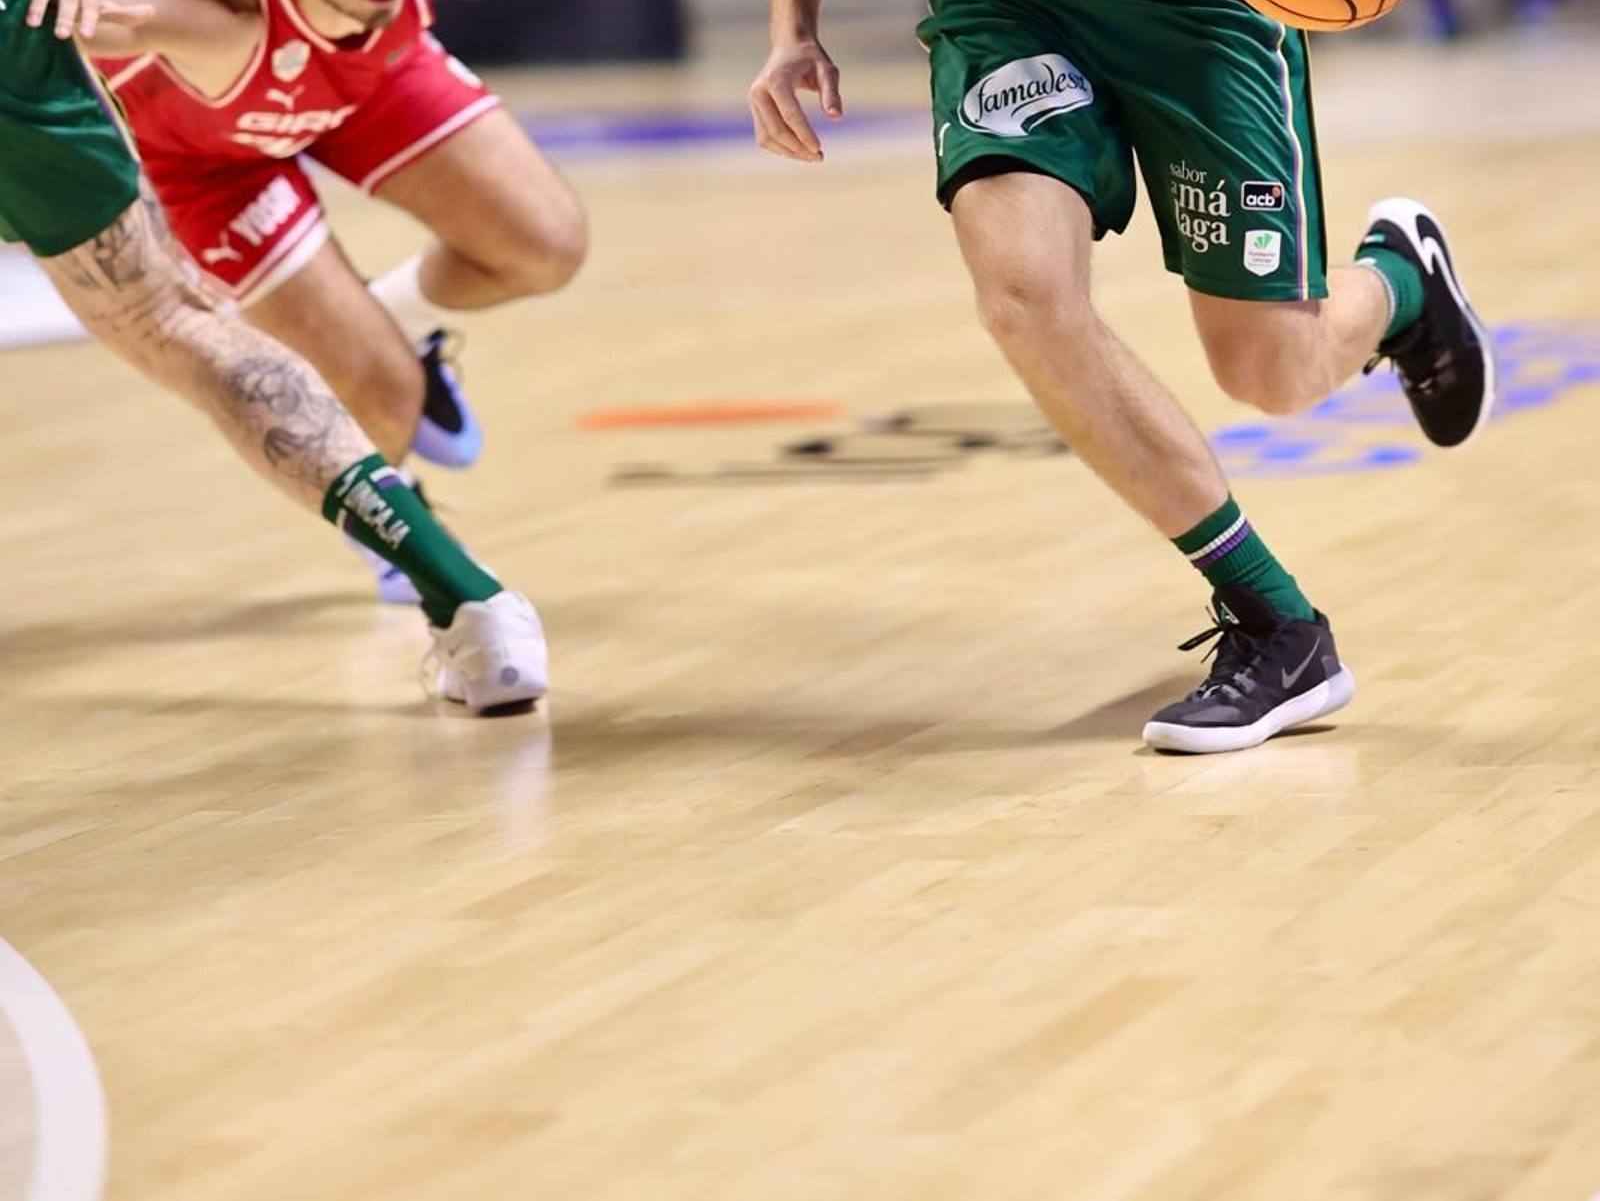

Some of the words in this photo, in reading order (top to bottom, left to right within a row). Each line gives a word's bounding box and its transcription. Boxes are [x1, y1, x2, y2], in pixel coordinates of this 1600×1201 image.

[1169, 159, 1208, 184] sabor
[1245, 192, 1275, 207] acb
[1174, 198, 1231, 253] laga
